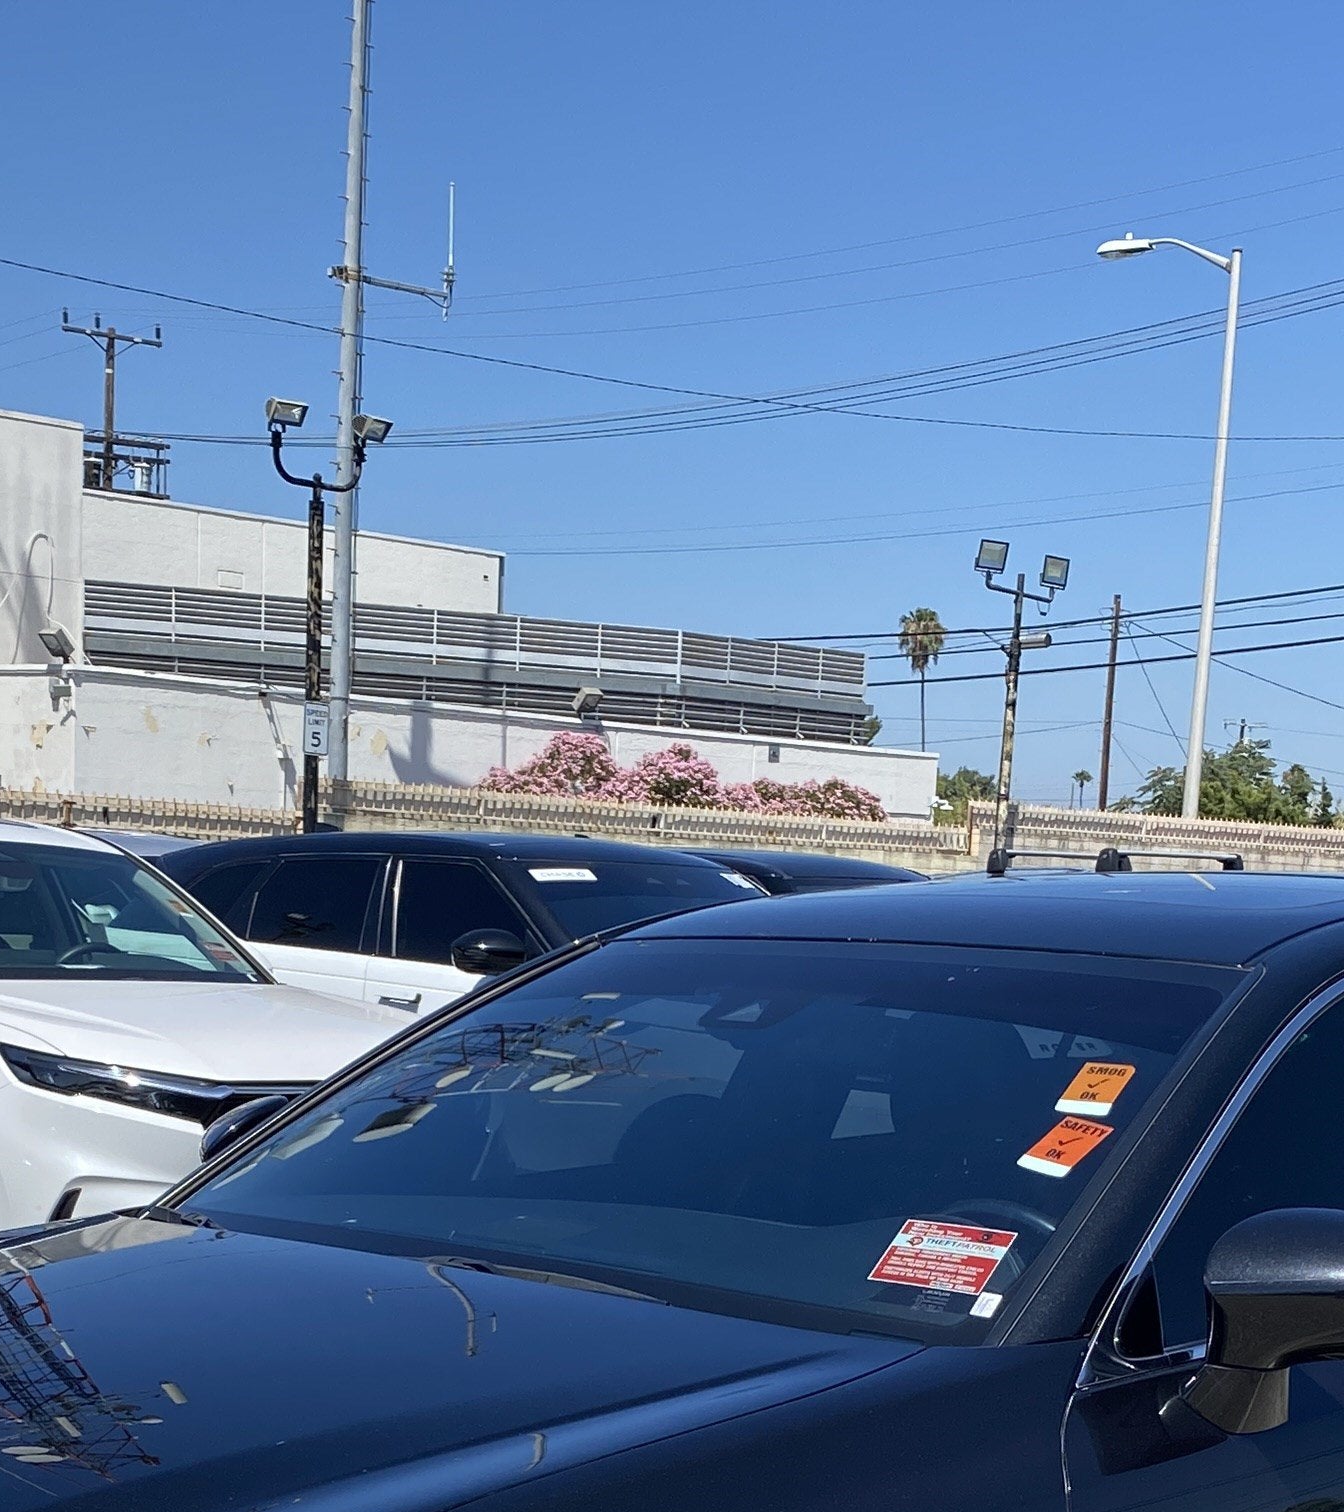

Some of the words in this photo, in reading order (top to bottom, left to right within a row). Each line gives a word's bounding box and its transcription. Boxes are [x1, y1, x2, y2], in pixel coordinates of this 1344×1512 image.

[306, 708, 327, 717] SPEED
[311, 732, 321, 747] 5
[1086, 1066, 1127, 1077] SMOG
[1080, 1091, 1100, 1101] OK
[1060, 1120, 1109, 1137] SAFETY
[1045, 1148, 1067, 1160] OK
